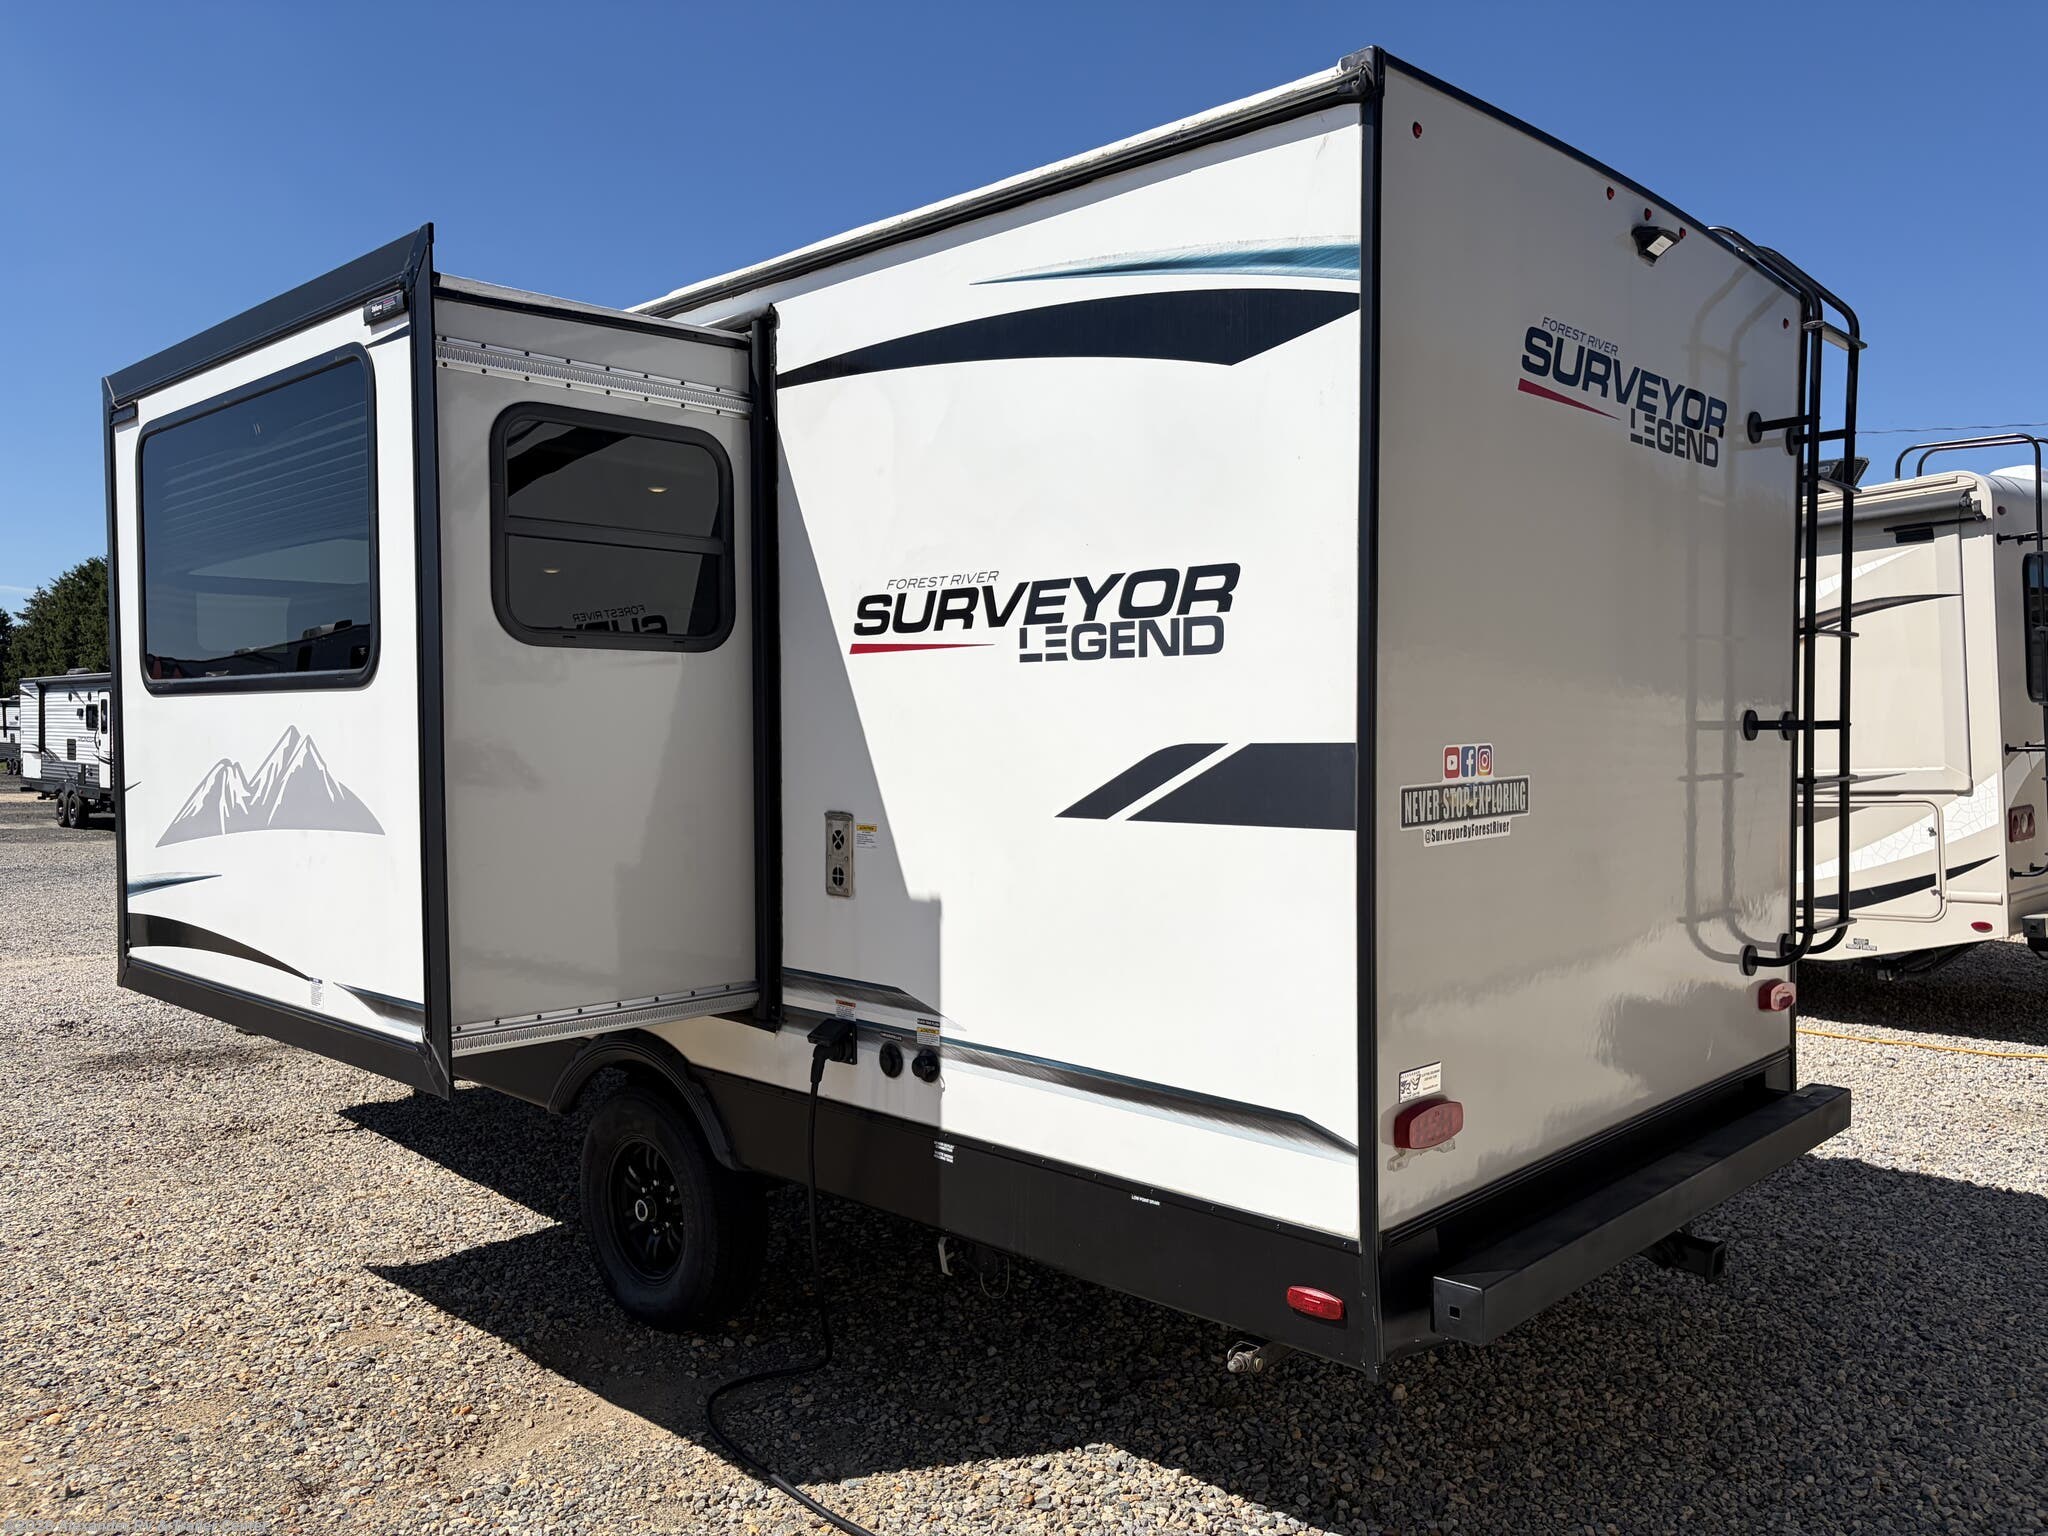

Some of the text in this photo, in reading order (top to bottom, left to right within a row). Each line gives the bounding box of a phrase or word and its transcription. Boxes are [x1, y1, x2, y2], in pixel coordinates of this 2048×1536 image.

[1541, 316, 1619, 356] FOREST RIVER
[1521, 326, 1727, 438] SURVEYOR
[1630, 407, 1718, 468] LEGEND
[853, 562, 1241, 636] SURVEYOR
[886, 570, 999, 591] FOREST RIVER
[1019, 615, 1224, 663] LEGEND
[1404, 781, 1527, 824] NEVER STOP EXPLORING
[1425, 820, 1510, 844] @SurveyorByForestRiver
